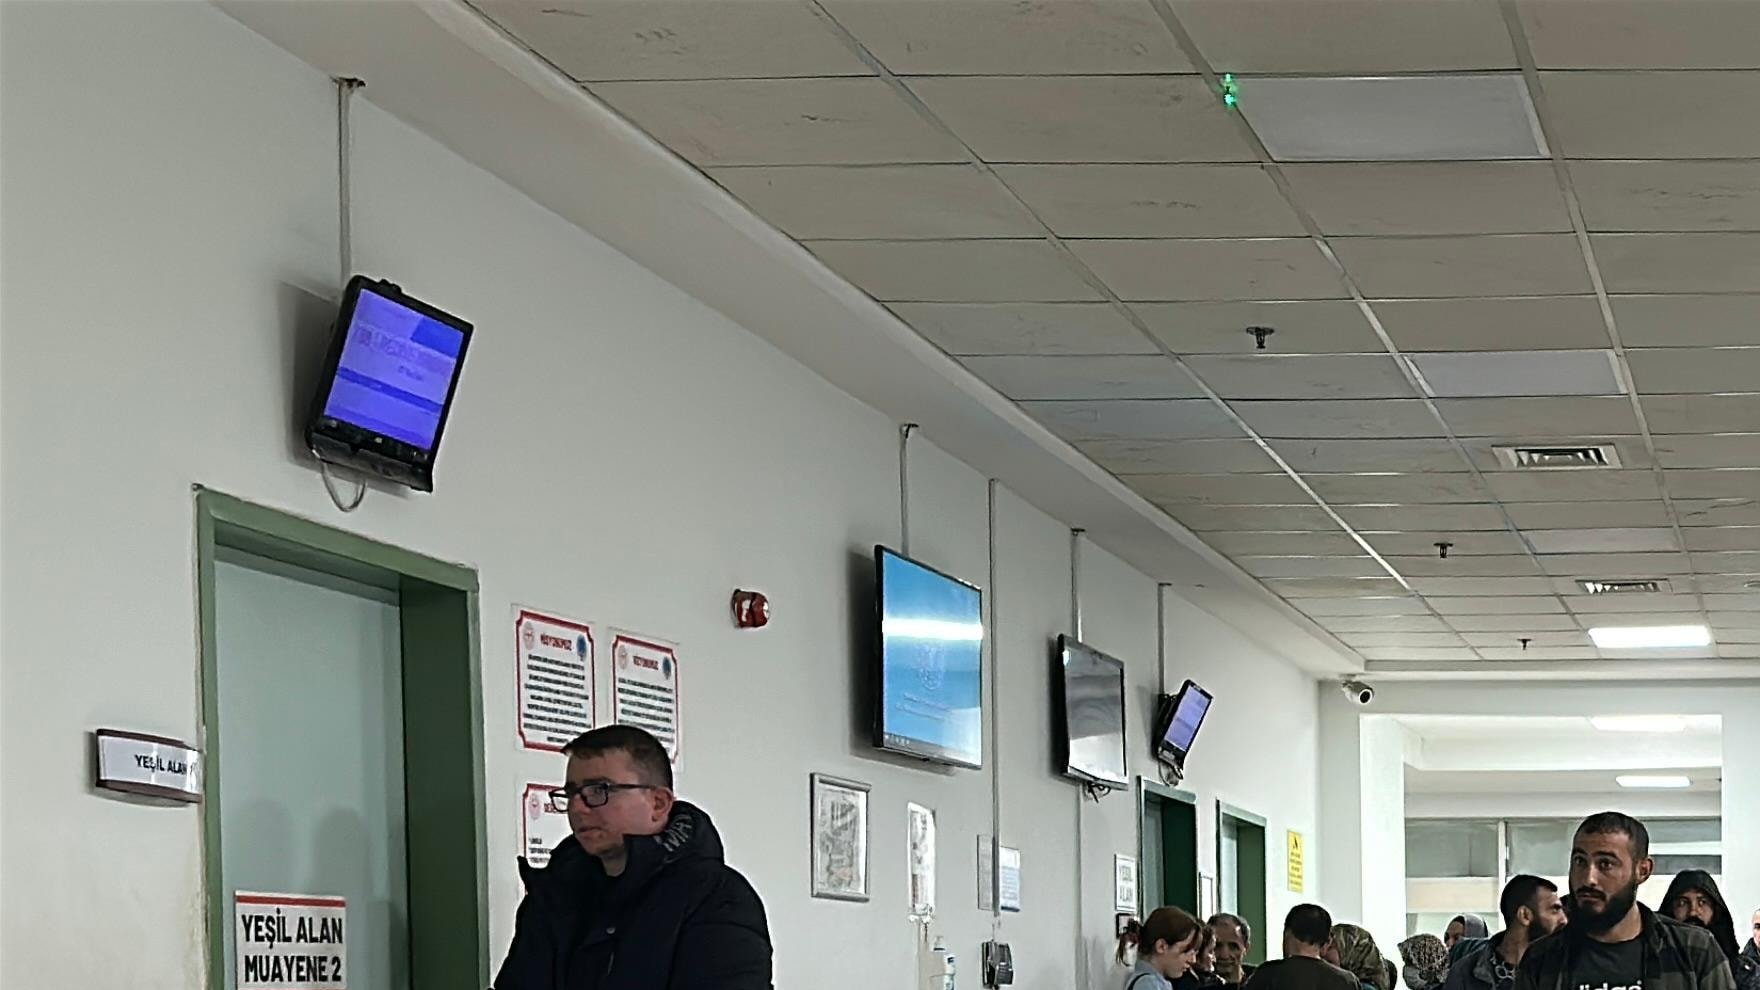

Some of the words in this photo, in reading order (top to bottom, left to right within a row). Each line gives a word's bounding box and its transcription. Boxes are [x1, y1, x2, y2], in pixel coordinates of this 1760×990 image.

[241, 907, 292, 950] YEŞİL
[296, 916, 343, 944] ALAN
[244, 954, 328, 983] MUAYENE
[331, 955, 342, 982] 2
